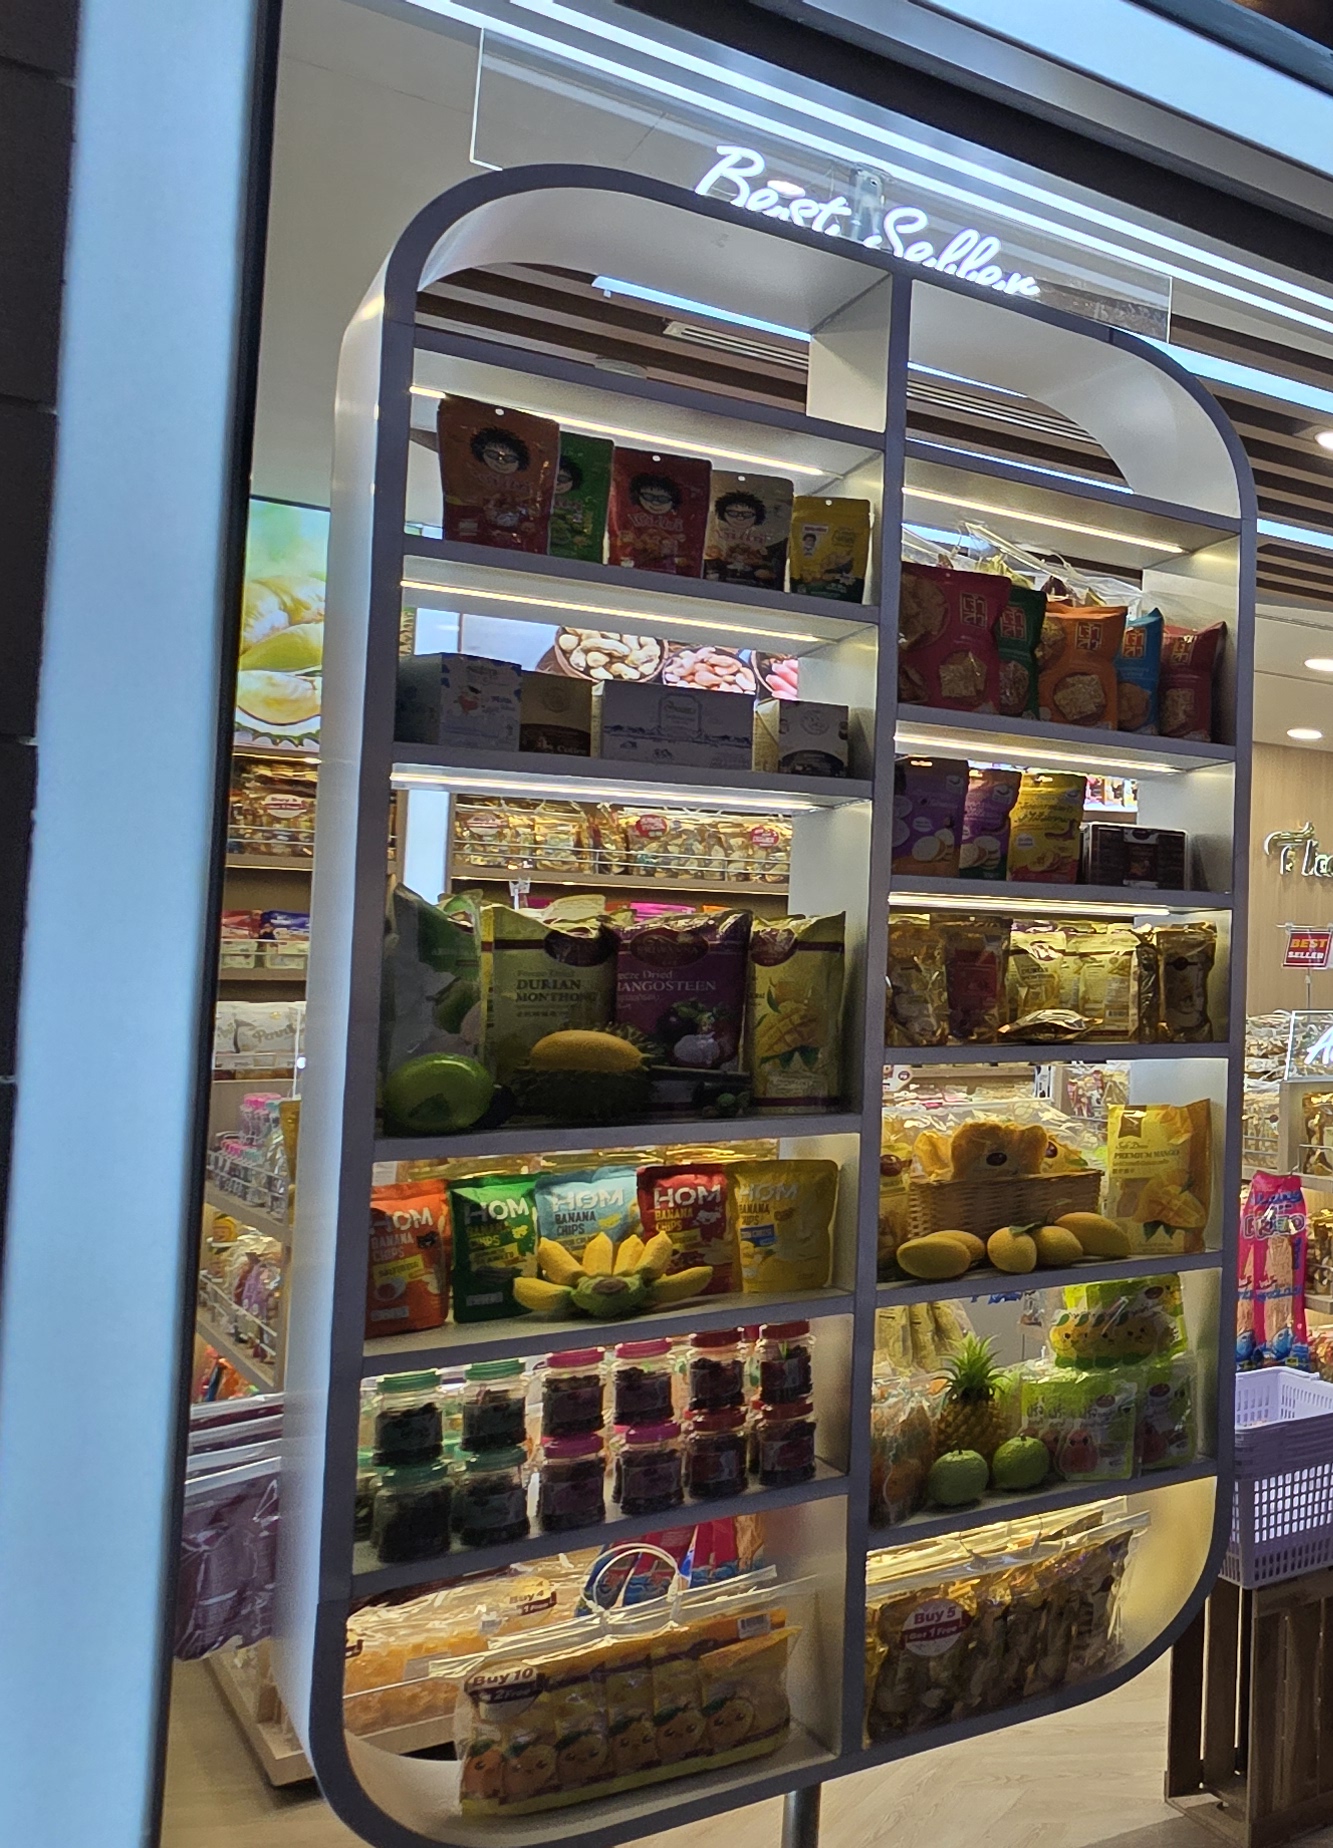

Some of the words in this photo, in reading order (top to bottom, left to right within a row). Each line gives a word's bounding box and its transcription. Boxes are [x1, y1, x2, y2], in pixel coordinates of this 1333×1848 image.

[1290, 939, 1328, 949] BEST
[1287, 950, 1325, 960] SELLER
[516, 979, 581, 991] DURIAN
[551, 1185, 625, 1212] HOM
[653, 1184, 722, 1209] HOM
[738, 1182, 799, 1201] HOM
[463, 1196, 530, 1225] HOM
[555, 1210, 597, 1224] BANANA
[654, 1208, 694, 1222] BANANA
[556, 1223, 585, 1237] CHIPS
[655, 1220, 683, 1232] CHIPS
[370, 1232, 415, 1250] BANANA
[914, 1610, 945, 1625] Buy
[947, 1605, 957, 1618] 5
[936, 1626, 958, 1636] Free
[472, 1672, 512, 1688] Buy
[514, 1667, 534, 1681] 10
